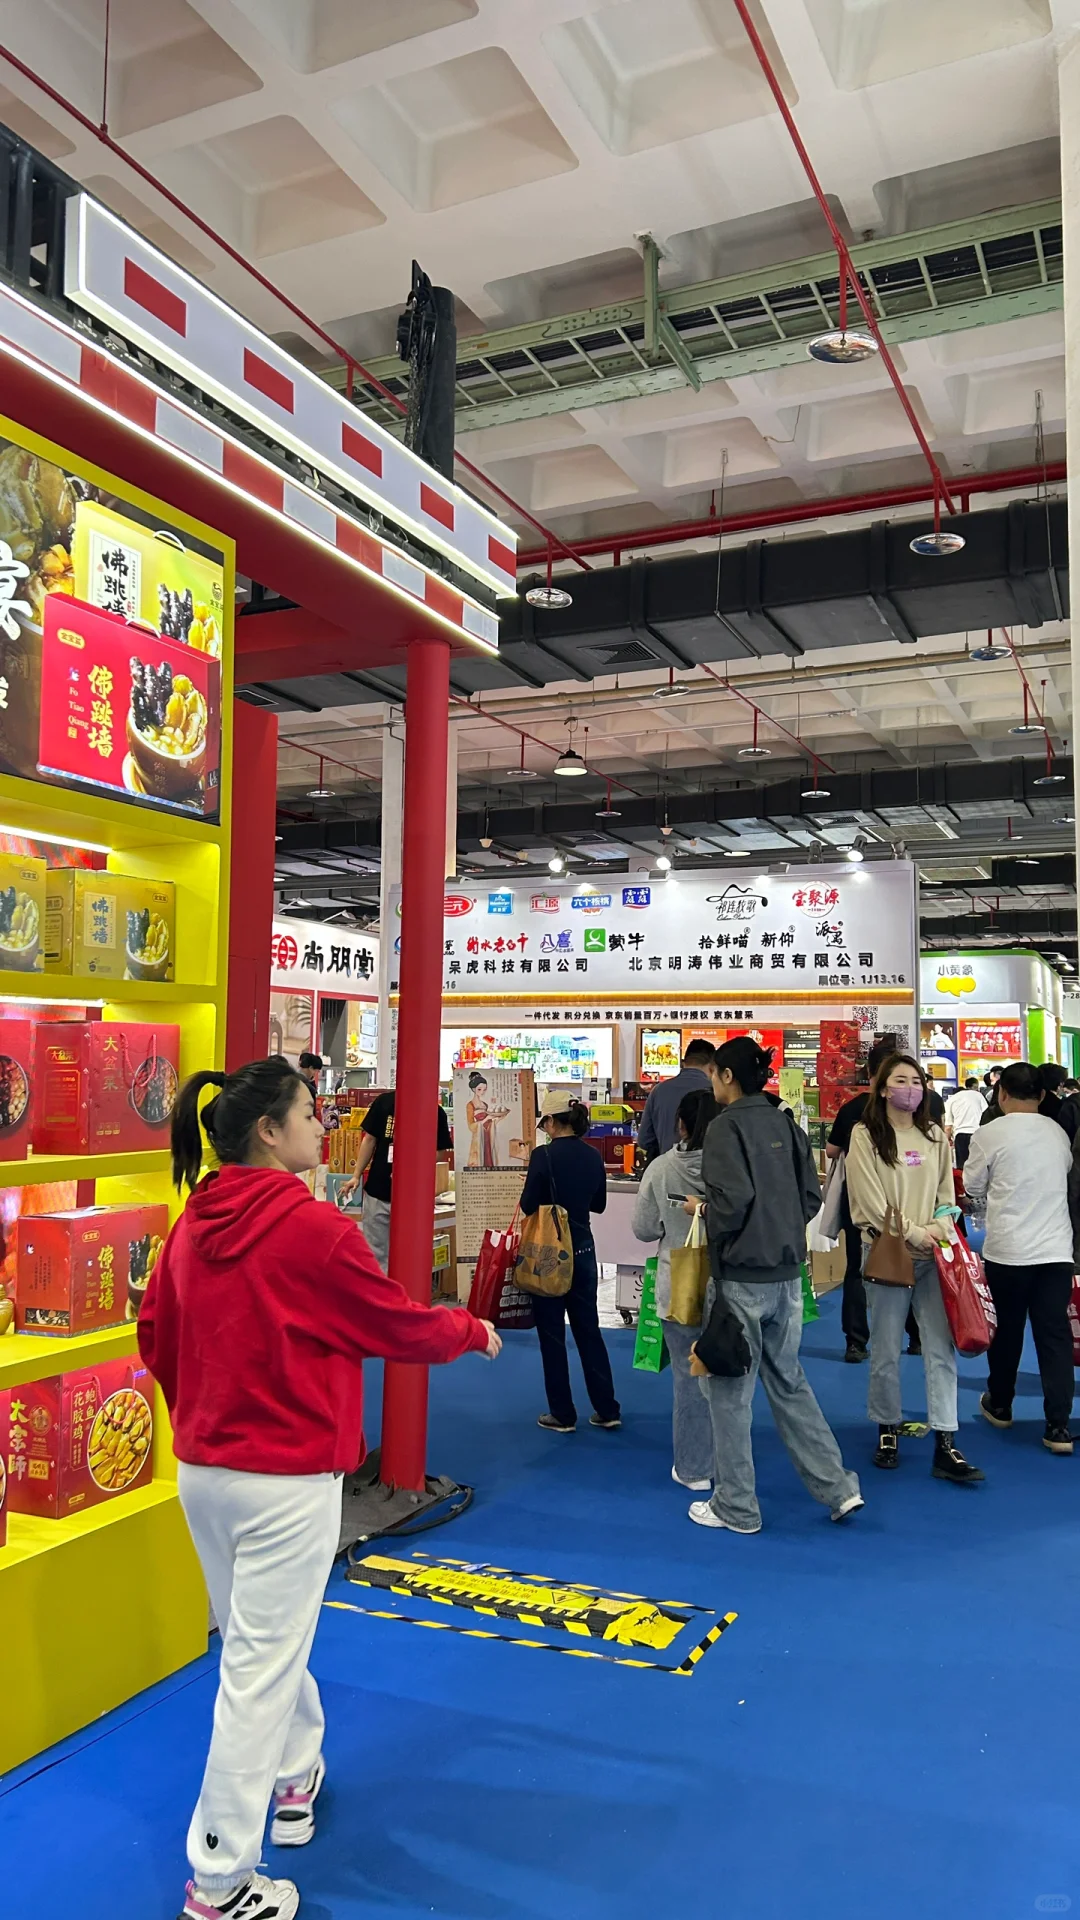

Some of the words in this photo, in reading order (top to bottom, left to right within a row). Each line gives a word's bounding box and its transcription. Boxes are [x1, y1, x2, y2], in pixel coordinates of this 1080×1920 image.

[69, 687, 78, 696] Fo
[68, 701, 84, 712] Tiao
[87, 664, 113, 758] 佛跳墙
[68, 715, 89, 730] Qiang
[531, 895, 559, 909] 汇源
[574, 895, 610, 907] 六个核桃
[792, 888, 840, 907] 宝聚源
[91, 897, 109, 944] 佛跳墙
[466, 932, 529, 955] 衡水老白干
[540, 929, 573, 953] 八喜
[608, 932, 645, 952] 蒙牛
[301, 940, 374, 980] 尚朋堂
[442, 957, 588, 974] 呆虎科技有限公司
[629, 952, 874, 972] 北京明涛伟业商贸有限公司
[938, 964, 974, 976] 小黄象
[525, 1010, 560, 1021] 一件代发
[564, 1010, 601, 1021] 积分兑换
[605, 1009, 709, 1020] 京东销量百万+银行授权
[714, 1010, 754, 1020] 京东慧采
[102, 1037, 119, 1091] 大盆菜
[85, 1387, 97, 1421] 鲍鱼
[73, 1390, 85, 1440] 花胶鸡
[470, 1577, 499, 1588] YOUR
[501, 1582, 538, 1593] WATCH
